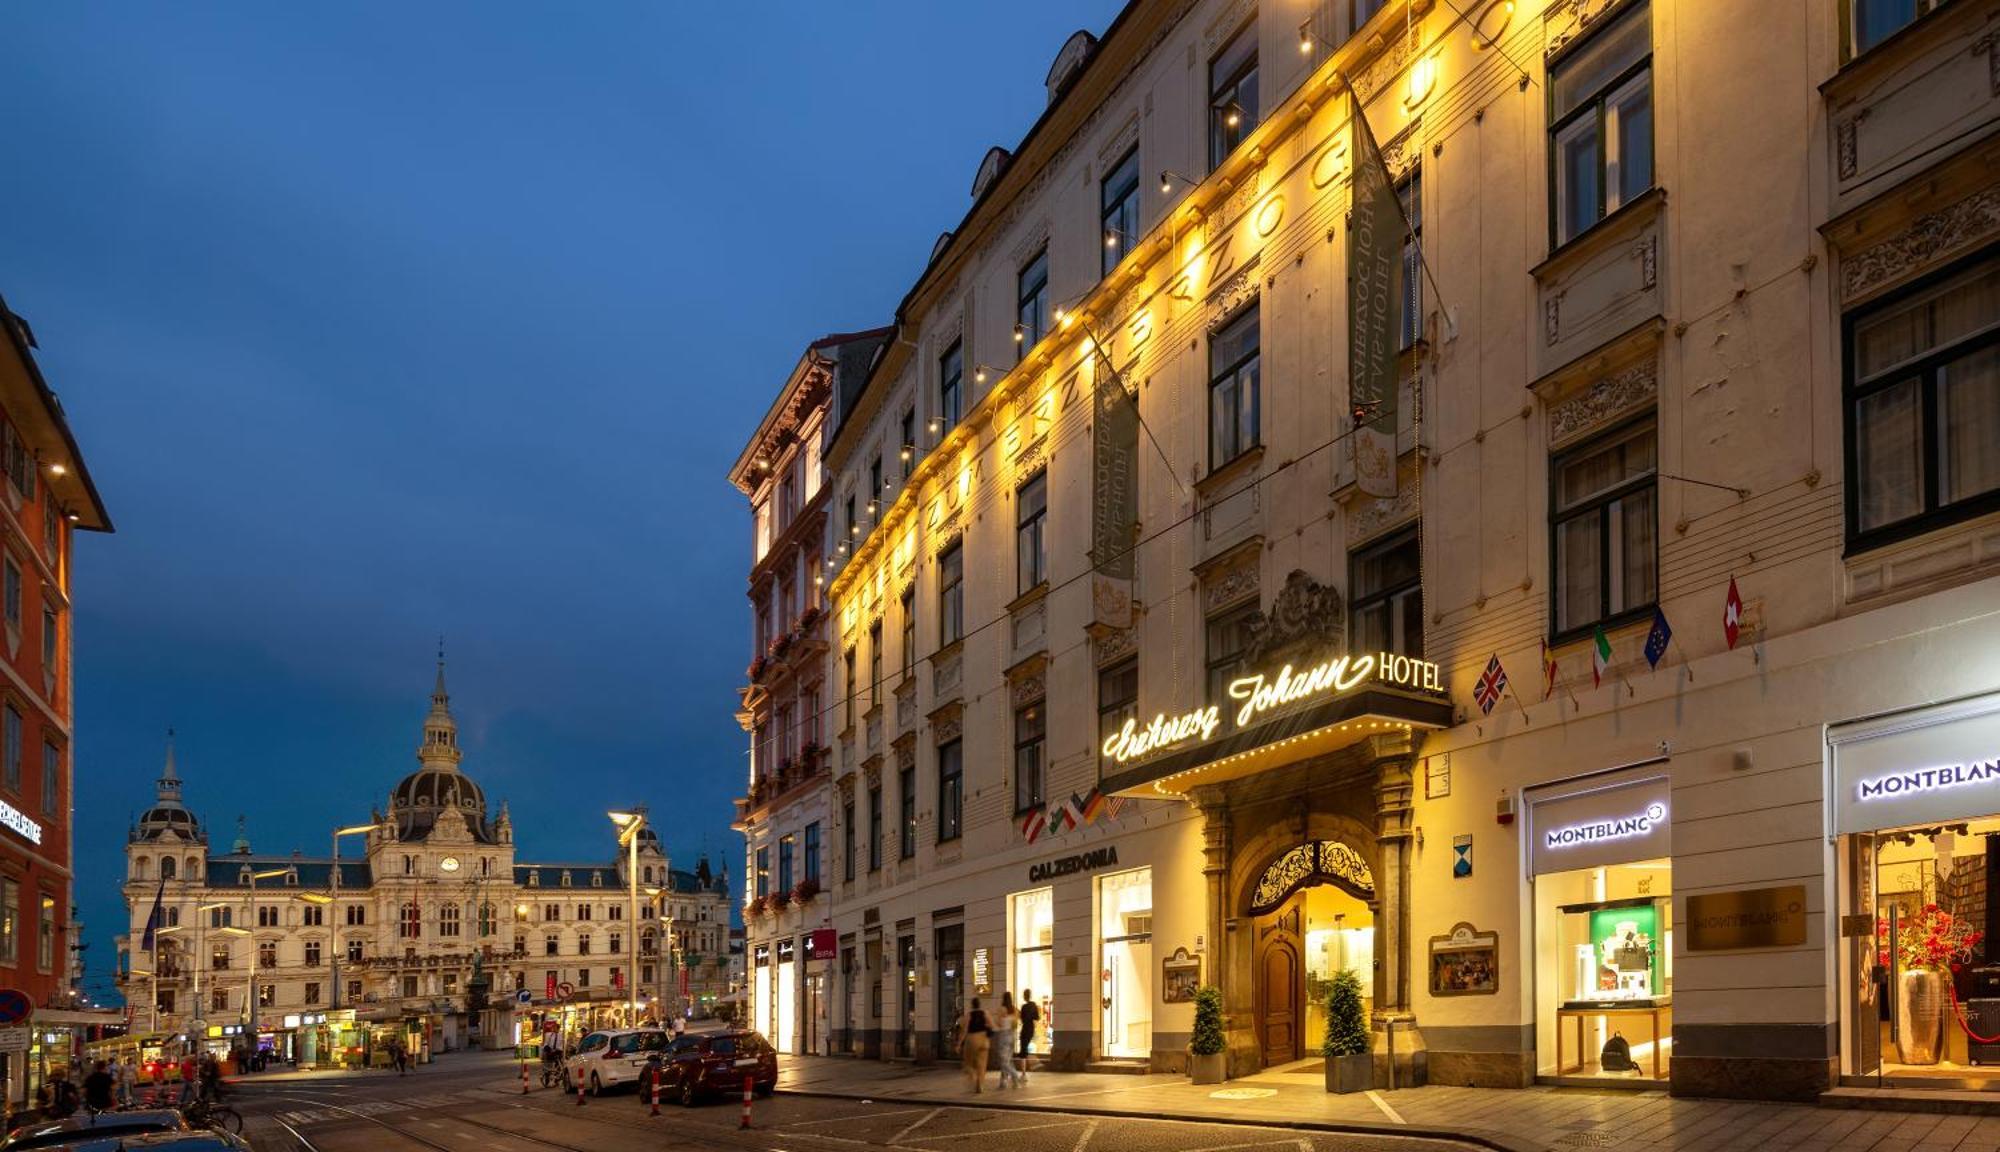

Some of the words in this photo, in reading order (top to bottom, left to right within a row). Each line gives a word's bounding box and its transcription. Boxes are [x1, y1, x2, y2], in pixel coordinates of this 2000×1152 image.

[1103, 705, 1219, 762] Erzherzog
[1229, 655, 1374, 727] Johann
[1380, 652, 1444, 692] HOTEL
[1548, 817, 1648, 846] MONTBLANC
[1029, 845, 1119, 882] CALZEDONIA
